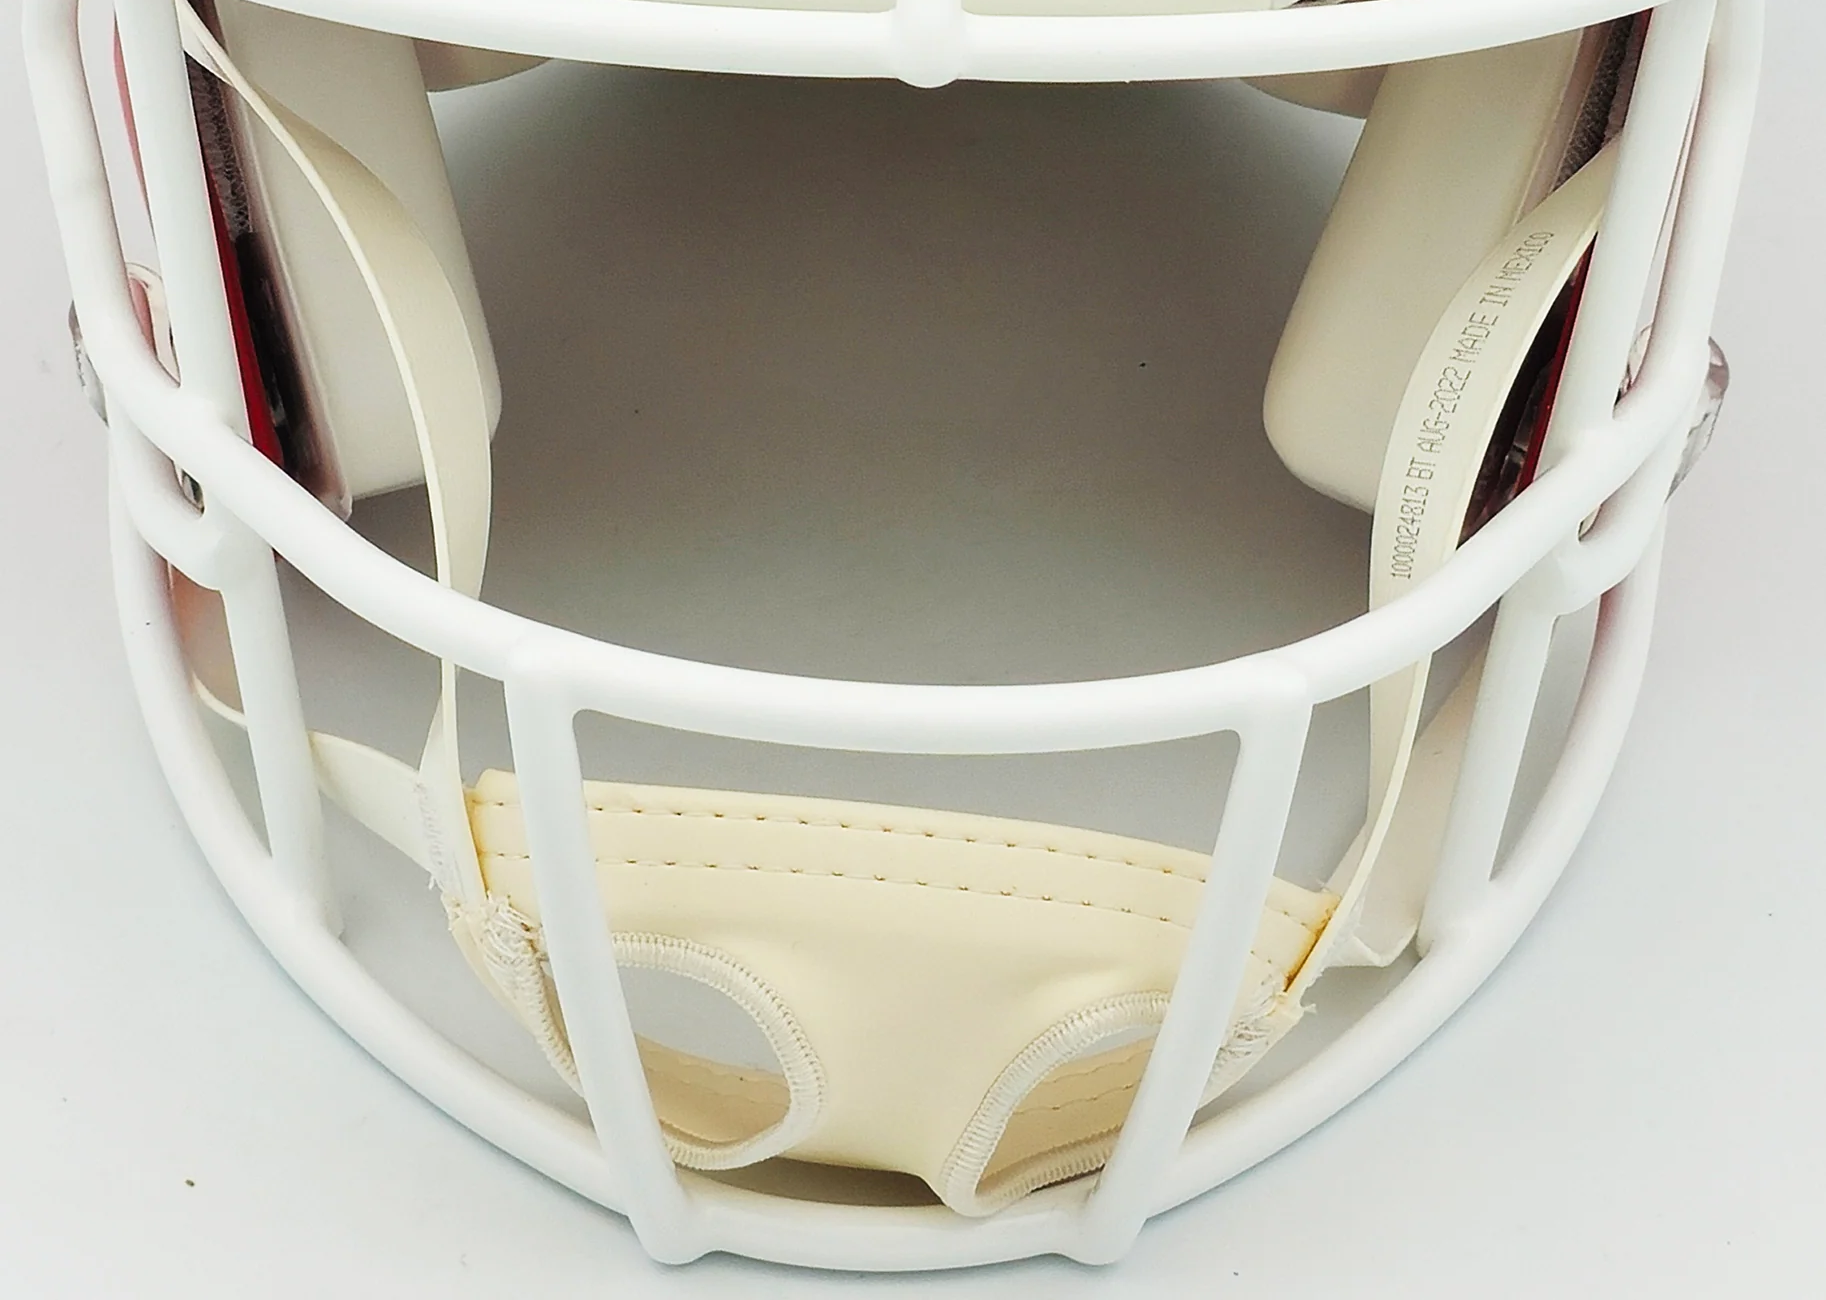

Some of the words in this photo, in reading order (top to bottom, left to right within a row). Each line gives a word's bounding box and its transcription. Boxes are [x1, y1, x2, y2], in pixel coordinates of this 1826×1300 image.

[1496, 231, 1554, 282] MEXICO
[1479, 284, 1517, 309] IN
[1449, 312, 1499, 364] MADE
[1417, 366, 1472, 454] AUG-2022
[1406, 457, 1437, 481] BT
[1390, 485, 1429, 580] 1000024813
